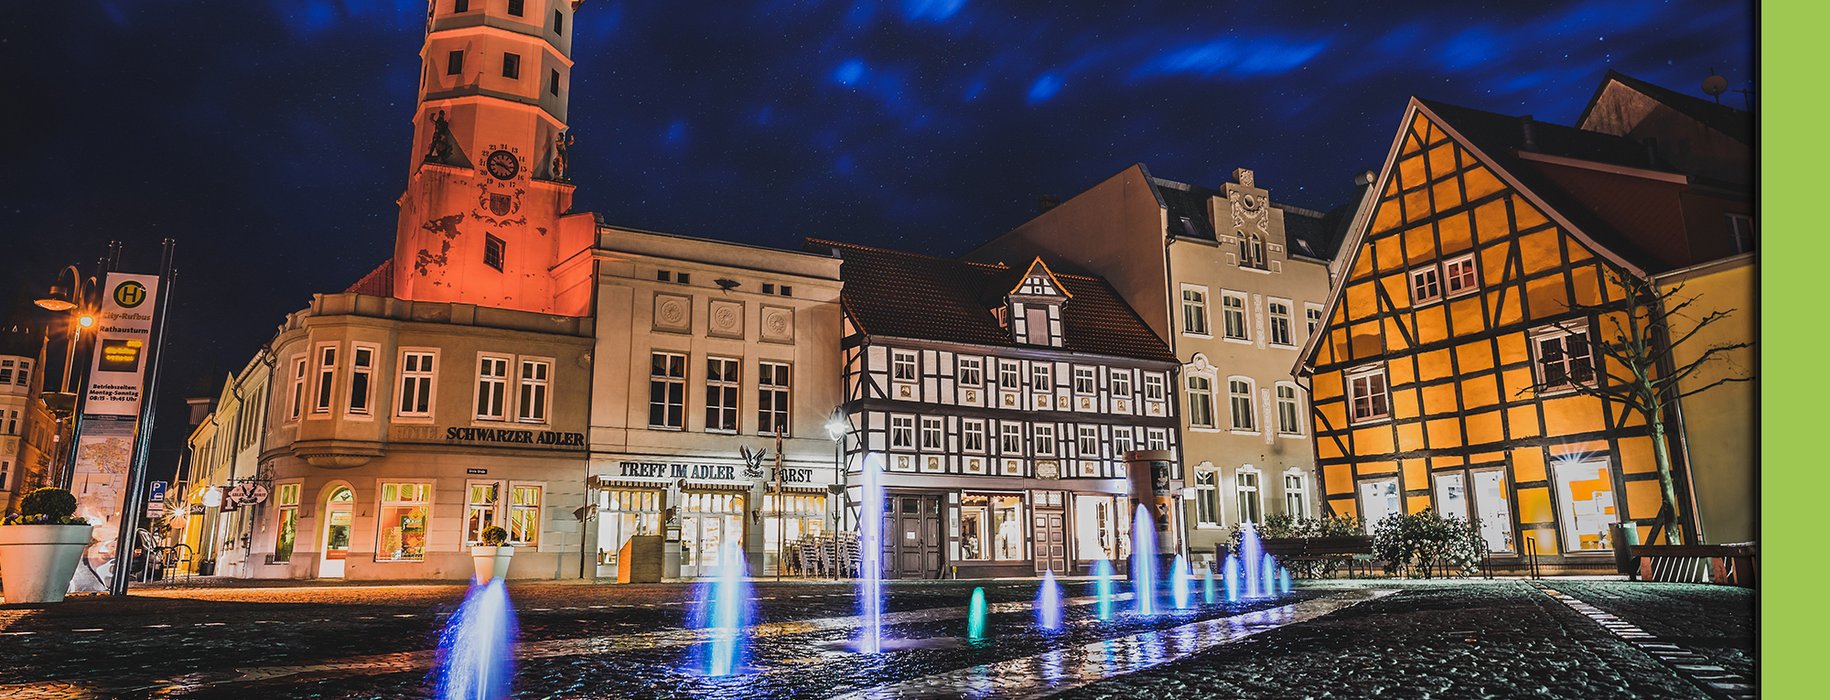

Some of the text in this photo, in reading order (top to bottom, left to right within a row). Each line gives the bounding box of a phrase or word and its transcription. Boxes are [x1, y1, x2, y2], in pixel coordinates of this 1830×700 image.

[122, 287, 138, 303] H
[102, 312, 151, 321] City-Rufbus
[100, 326, 149, 334] Rathausturm
[446, 427, 534, 444] SCHWARZER
[536, 432, 585, 447] ADLER
[619, 461, 667, 478] TREFF
[669, 463, 688, 479] IM
[691, 464, 735, 480] ADLER
[153, 482, 161, 492] P
